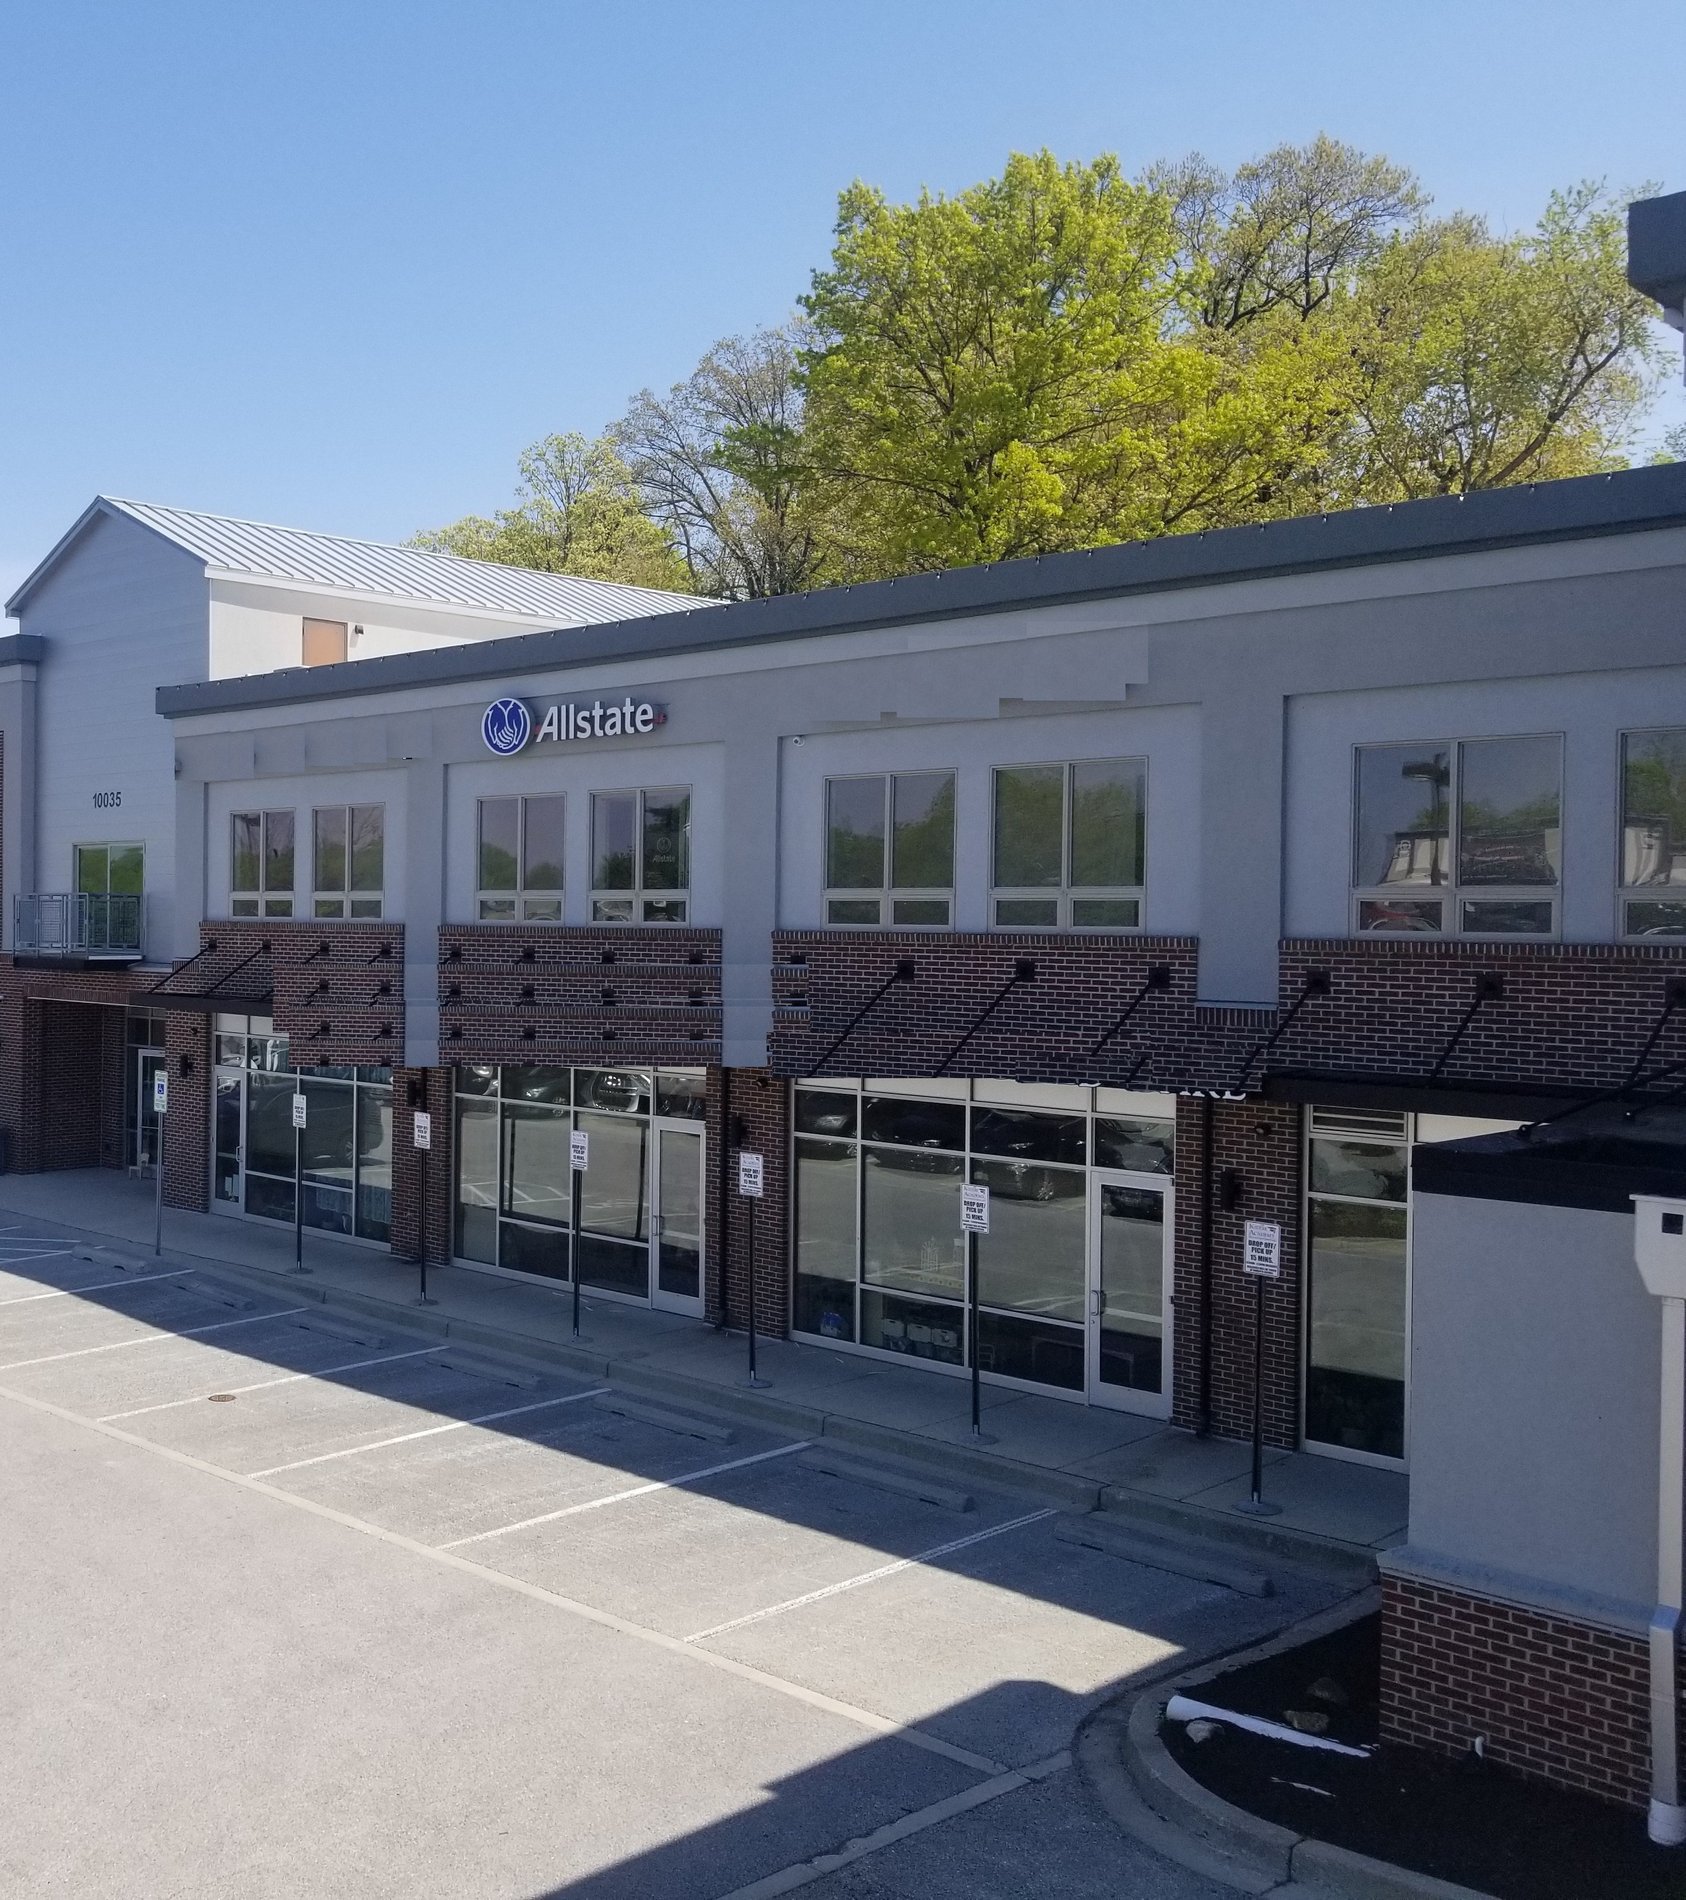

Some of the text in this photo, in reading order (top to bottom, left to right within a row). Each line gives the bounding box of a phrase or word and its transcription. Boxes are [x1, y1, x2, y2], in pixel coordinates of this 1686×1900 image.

[535, 697, 654, 743] Allstate
[92, 791, 122, 808] 10035
[1248, 1239, 1263, 1247] DROP
[1251, 1246, 1274, 1256] PICK UP
